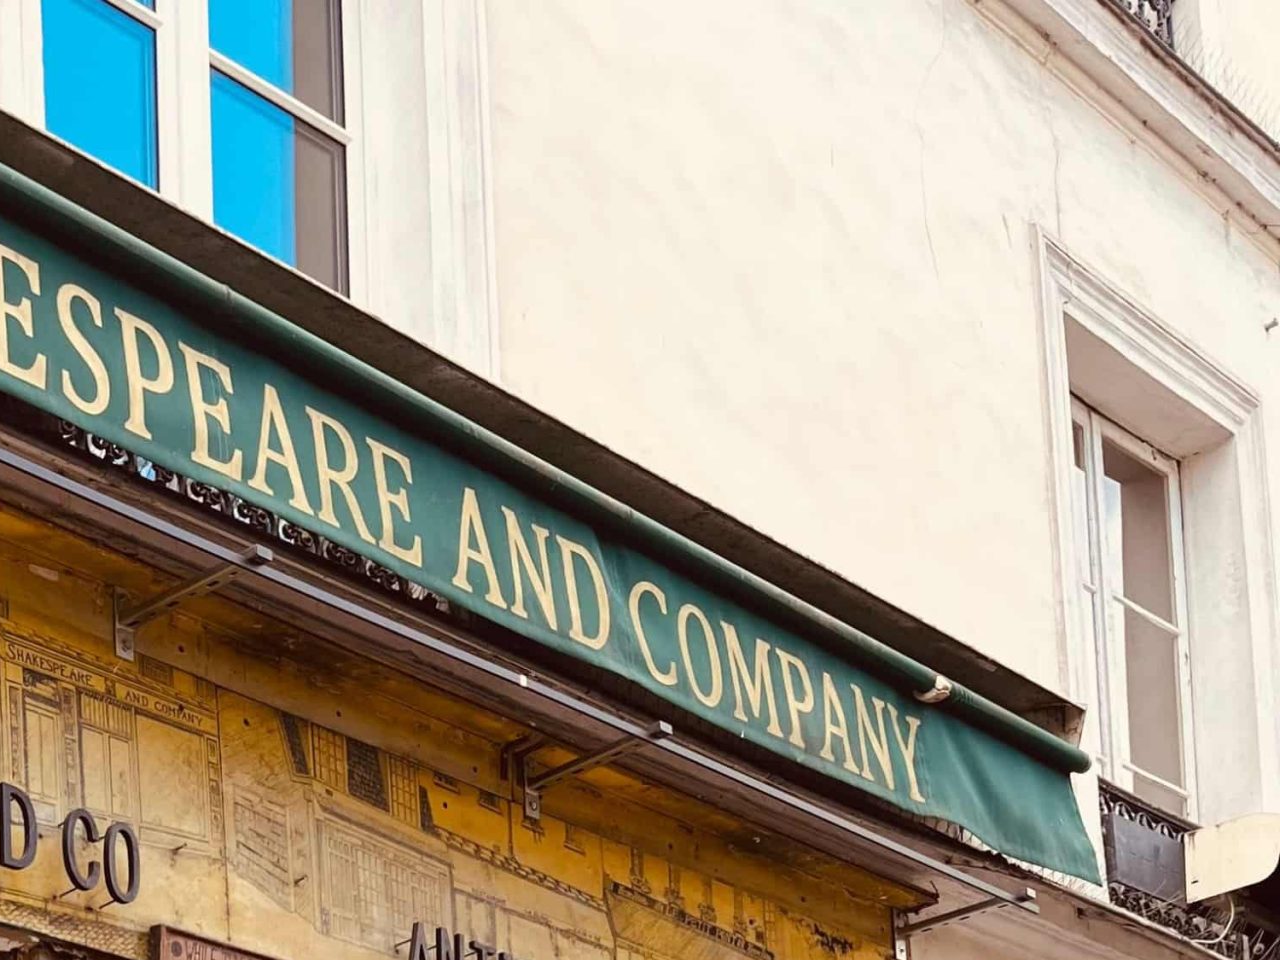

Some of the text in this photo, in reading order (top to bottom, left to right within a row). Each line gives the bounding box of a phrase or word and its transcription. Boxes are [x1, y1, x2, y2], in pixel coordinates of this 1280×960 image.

[7, 643, 203, 727] SHAKESPEARE AND COMPANY
[452, 486, 611, 652] AND
[628, 580, 926, 803] COMPANY
[62, 808, 141, 905] CO
